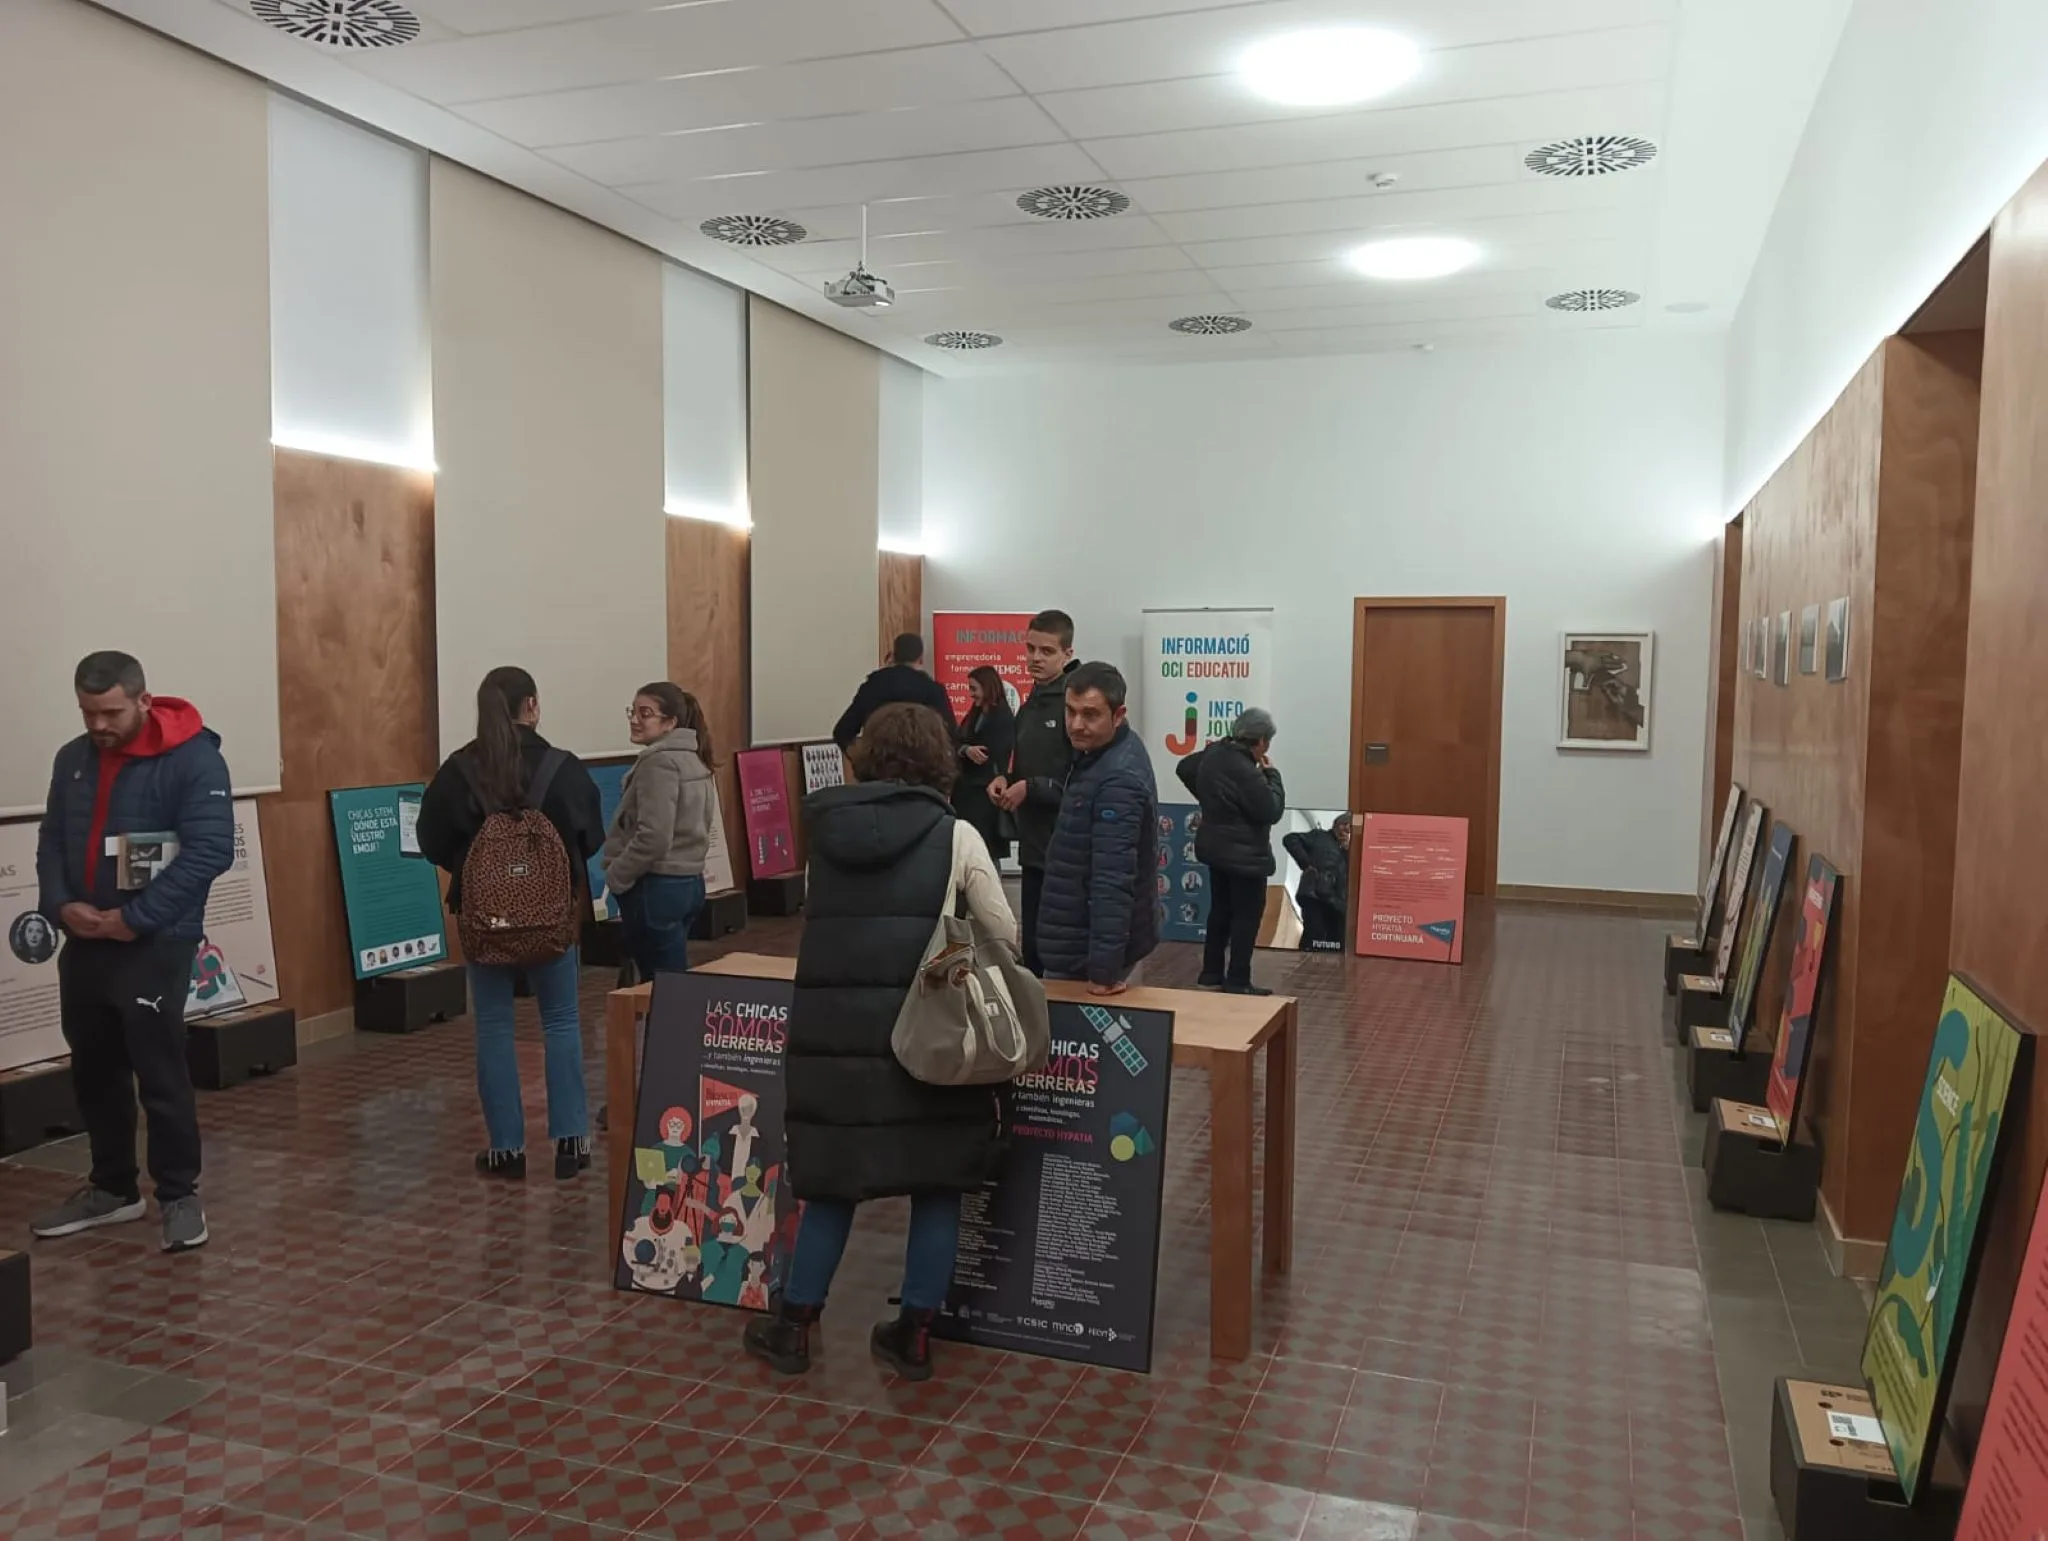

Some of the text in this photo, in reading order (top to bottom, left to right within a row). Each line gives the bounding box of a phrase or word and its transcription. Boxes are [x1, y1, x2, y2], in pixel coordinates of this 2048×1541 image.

[956, 628, 1027, 644] INFORMAC
[1162, 634, 1250, 655] INFORMACIÓ
[1162, 662, 1250, 678] OCI EDUCATIU
[1208, 701, 1244, 718] INFO
[1206, 720, 1236, 738] JOV
[1372, 914, 1414, 924] PROYECTO
[1312, 939, 1341, 949] FUTURO
[706, 1000, 788, 1021] LAS CHICAS
[704, 1012, 788, 1047] SOMOS
[703, 1033, 783, 1054] GUERRERAS
[1050, 1039, 1100, 1059] HICAS
[1052, 1094, 1095, 1109] ingenieras
[1056, 1128, 1094, 1144] HYPATIA
[1024, 1317, 1049, 1328] CSIC
